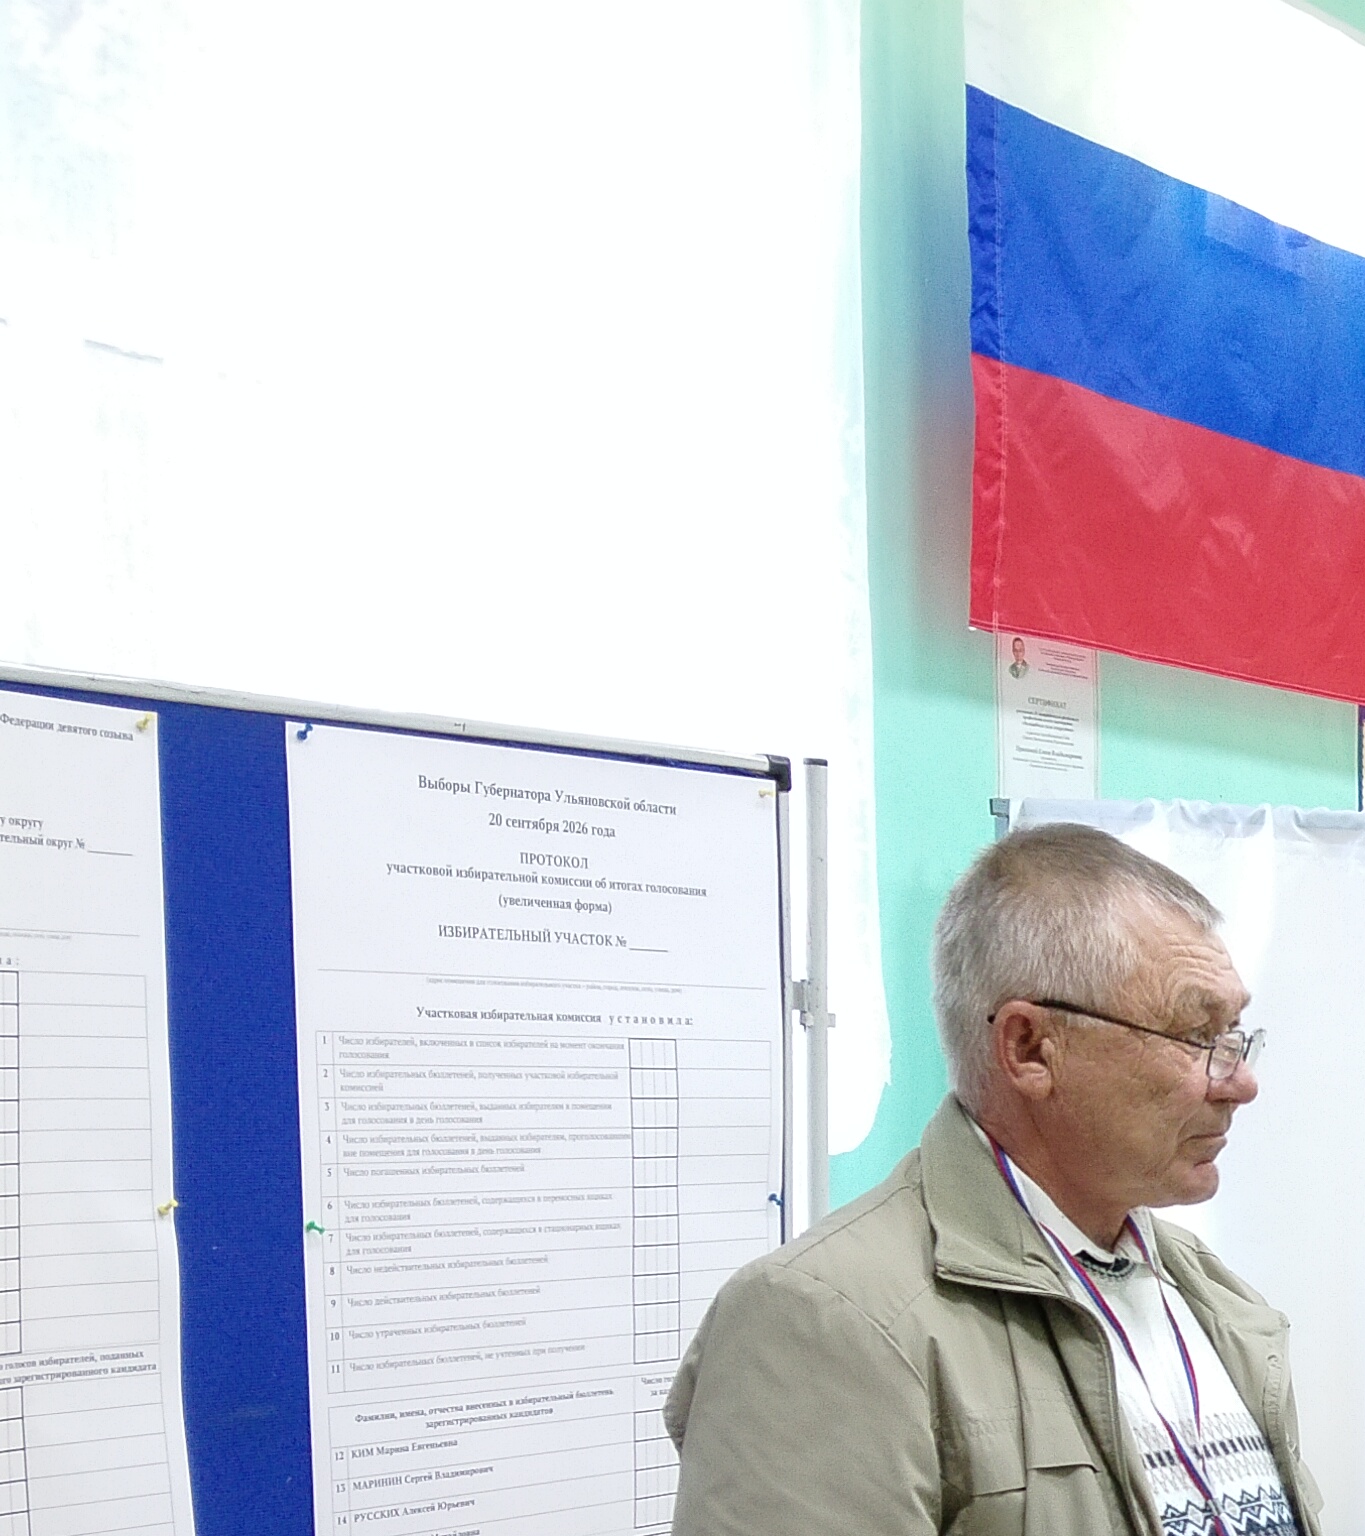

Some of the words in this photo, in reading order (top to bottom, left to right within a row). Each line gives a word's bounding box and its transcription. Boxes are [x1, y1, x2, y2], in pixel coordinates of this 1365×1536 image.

[57, 723, 97, 737] девятого
[99, 728, 134, 741] созыва
[418, 774, 471, 795] Выборы
[474, 780, 551, 804] Губернатора
[554, 789, 630, 811] Ульяновской
[633, 799, 677, 816] области
[8, 817, 44, 831] округу
[488, 812, 502, 827] 20
[505, 817, 560, 834] сентября
[562, 819, 588, 835] 2026
[591, 826, 616, 838] года
[46, 837, 73, 851] округ
[75, 837, 85, 850] №
[519, 851, 589, 870] ПРОТОКОЛ
[386, 862, 453, 878] участковой
[456, 866, 538, 884] избирательной
[541, 875, 593, 888] комиссии
[594, 877, 607, 889] об
[609, 880, 643, 892] итогах
[645, 883, 707, 897] голосования
[498, 893, 572, 910] (увеличенная
[574, 898, 612, 915] форма)
[438, 924, 552, 944] ИЗБИРАТЕЛЬНЫЙ
[554, 931, 613, 947] УЧАСТОК
[615, 935, 627, 948] №
[416, 1006, 478, 1020] Участковая
[480, 1008, 554, 1023] избирательная
[556, 1012, 602, 1023] комиссия
[325, 1135, 331, 1145] 4
[327, 1201, 333, 1210] 6
[329, 1266, 335, 1276] 8
[330, 1299, 336, 1308] 9
[330, 1332, 340, 1341] 10
[38, 1352, 98, 1367] избирателей,
[331, 1364, 340, 1374] 11
[335, 1451, 344, 1461] 12
[351, 1447, 374, 1459] КИМ
[376, 1444, 409, 1456] Марина
[411, 1439, 458, 1451] Евгеньевна
[353, 1476, 402, 1491] МАРИНИН
[404, 1472, 433, 1485] Сергей
[435, 1465, 494, 1480] Владимирович
[336, 1483, 346, 1493] 13
[354, 1508, 400, 1523] РУССКИХ
[402, 1503, 435, 1516] Алексей
[437, 1498, 475, 1511] Юрьевич
[337, 1516, 347, 1525] 14
